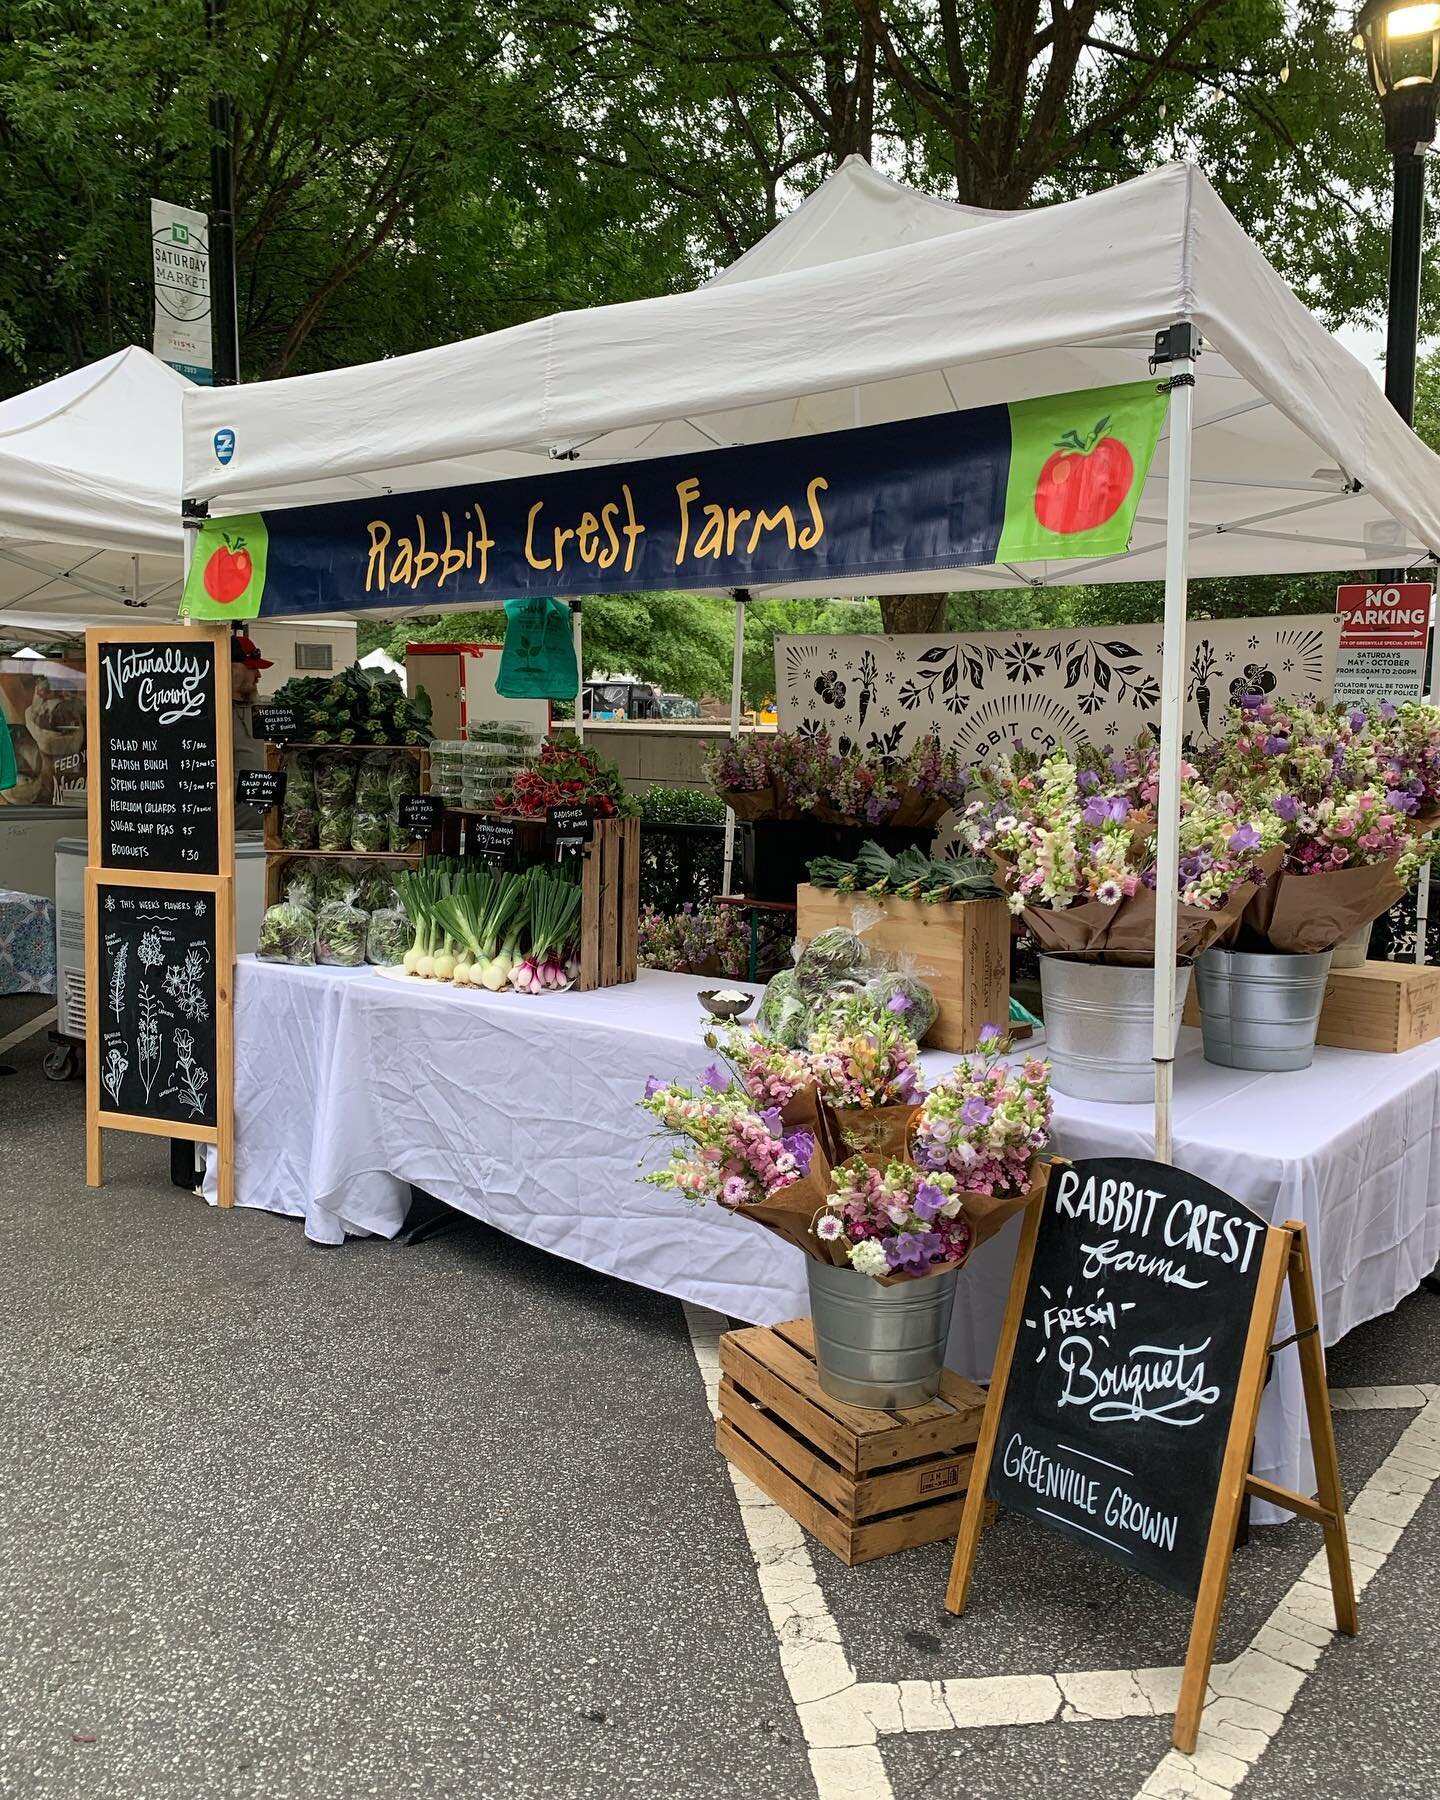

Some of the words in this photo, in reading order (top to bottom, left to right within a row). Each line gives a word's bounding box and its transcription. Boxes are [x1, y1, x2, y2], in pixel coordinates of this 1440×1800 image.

[155, 248, 207, 273] SATURDAY
[156, 266, 208, 290] MARKET
[365, 502, 496, 592] Rabbit
[523, 484, 645, 573] Crest
[675, 477, 828, 566] Farms
[1365, 588, 1400, 607] NO
[1341, 608, 1425, 625] PARKING
[1371, 659, 1410, 667] OCTOBER
[101, 647, 210, 710] Naturally
[137, 677, 205, 725] Grown
[110, 738, 138, 751] SALAD
[142, 739, 158, 751] MIX
[970, 722, 1019, 768] ABBIT
[54, 753, 80, 773] FEED
[110, 758, 140, 771] RADISH
[143, 758, 169, 771] BUNCH
[110, 778, 137, 792] SPRING
[139, 779, 165, 791] ONIONS
[110, 798, 142, 814] HEIRLOOM
[144, 802, 177, 813] COLLARDS
[553, 809, 583, 819] RADISHES
[110, 819, 136, 833] SUGAR
[137, 823, 153, 834] SNAP
[156, 824, 174, 835] PEAS
[182, 825, 196, 836] $5
[557, 820, 570, 828] $5
[111, 843, 150, 858] BOUQUETS
[181, 848, 199, 861] $30
[119, 899, 135, 909] THIS
[164, 901, 191, 910] FLOWERS
[1055, 1170, 1167, 1238] RABBIT
[1163, 1198, 1264, 1273] CREST
[1043, 1300, 1116, 1339] FRESH
[1057, 1335, 1220, 1425] Bouquets
[1002, 1432, 1101, 1515] GREENVILLE
[1104, 1487, 1179, 1552] GROWN
